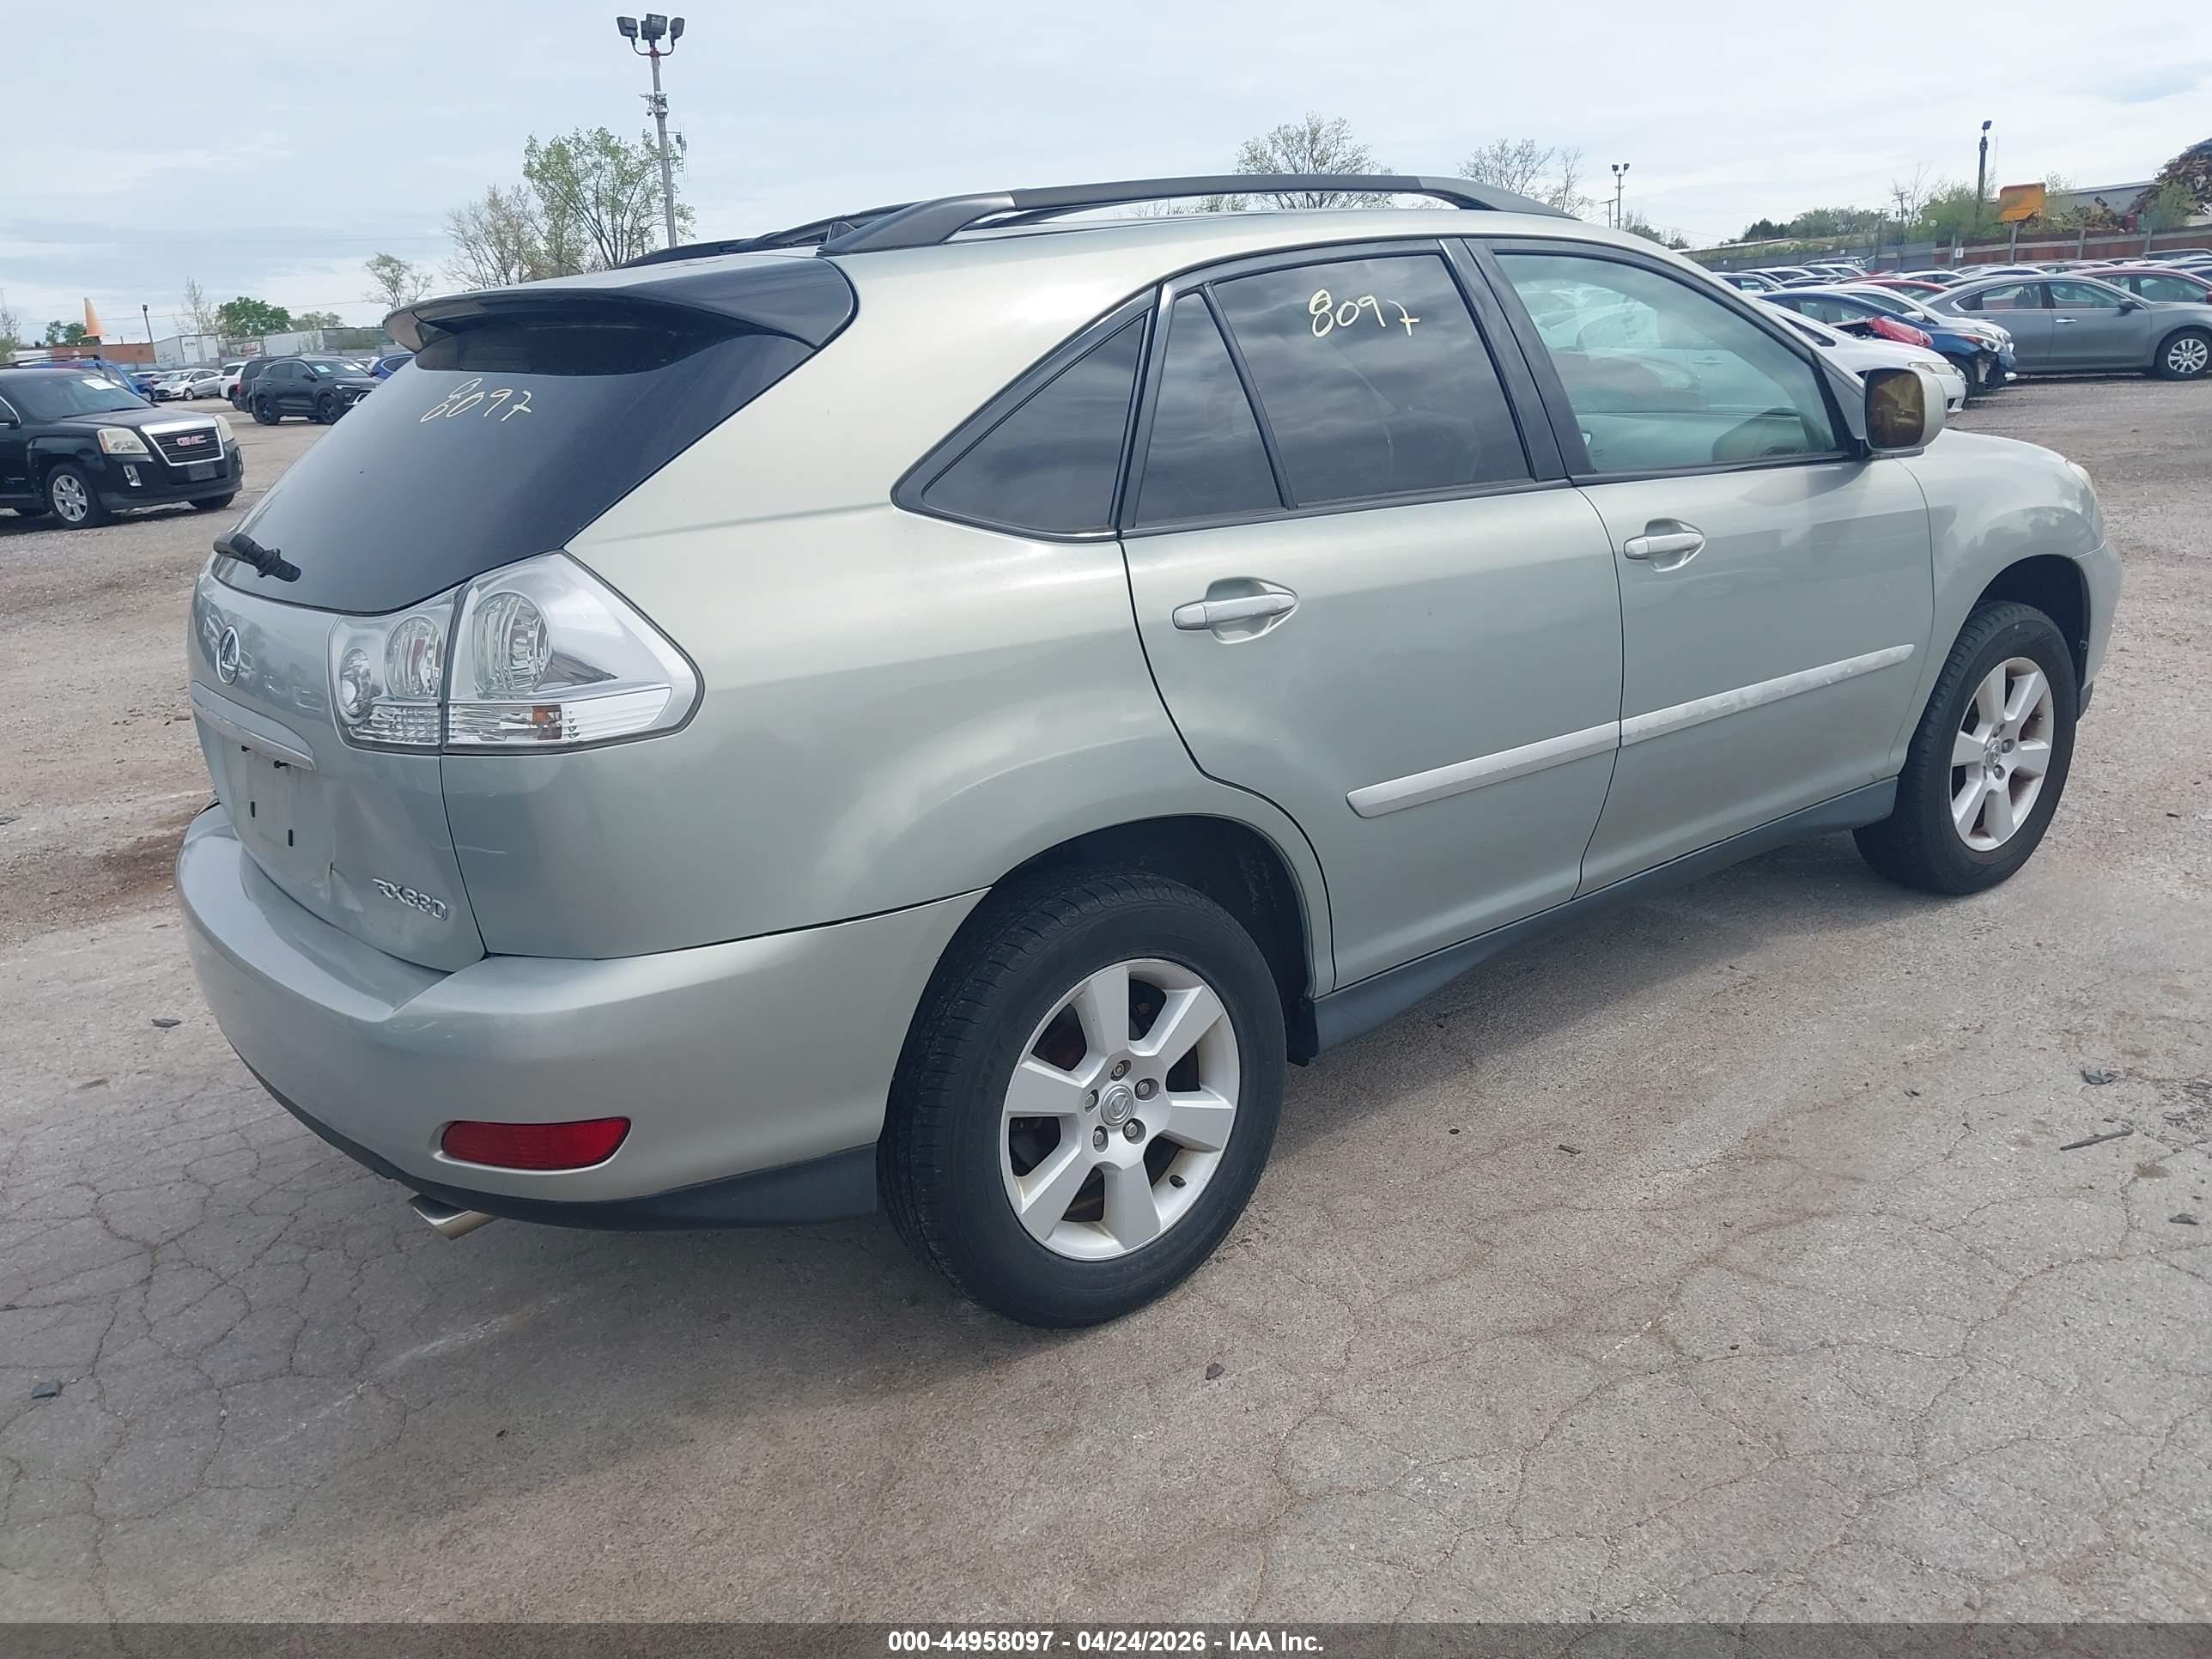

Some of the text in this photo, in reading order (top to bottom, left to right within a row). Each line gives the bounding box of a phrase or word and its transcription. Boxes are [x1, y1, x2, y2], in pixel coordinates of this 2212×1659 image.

[1309, 289, 1421, 337] 8097
[419, 377, 532, 423] 8097
[176, 434, 207, 447] GMC
